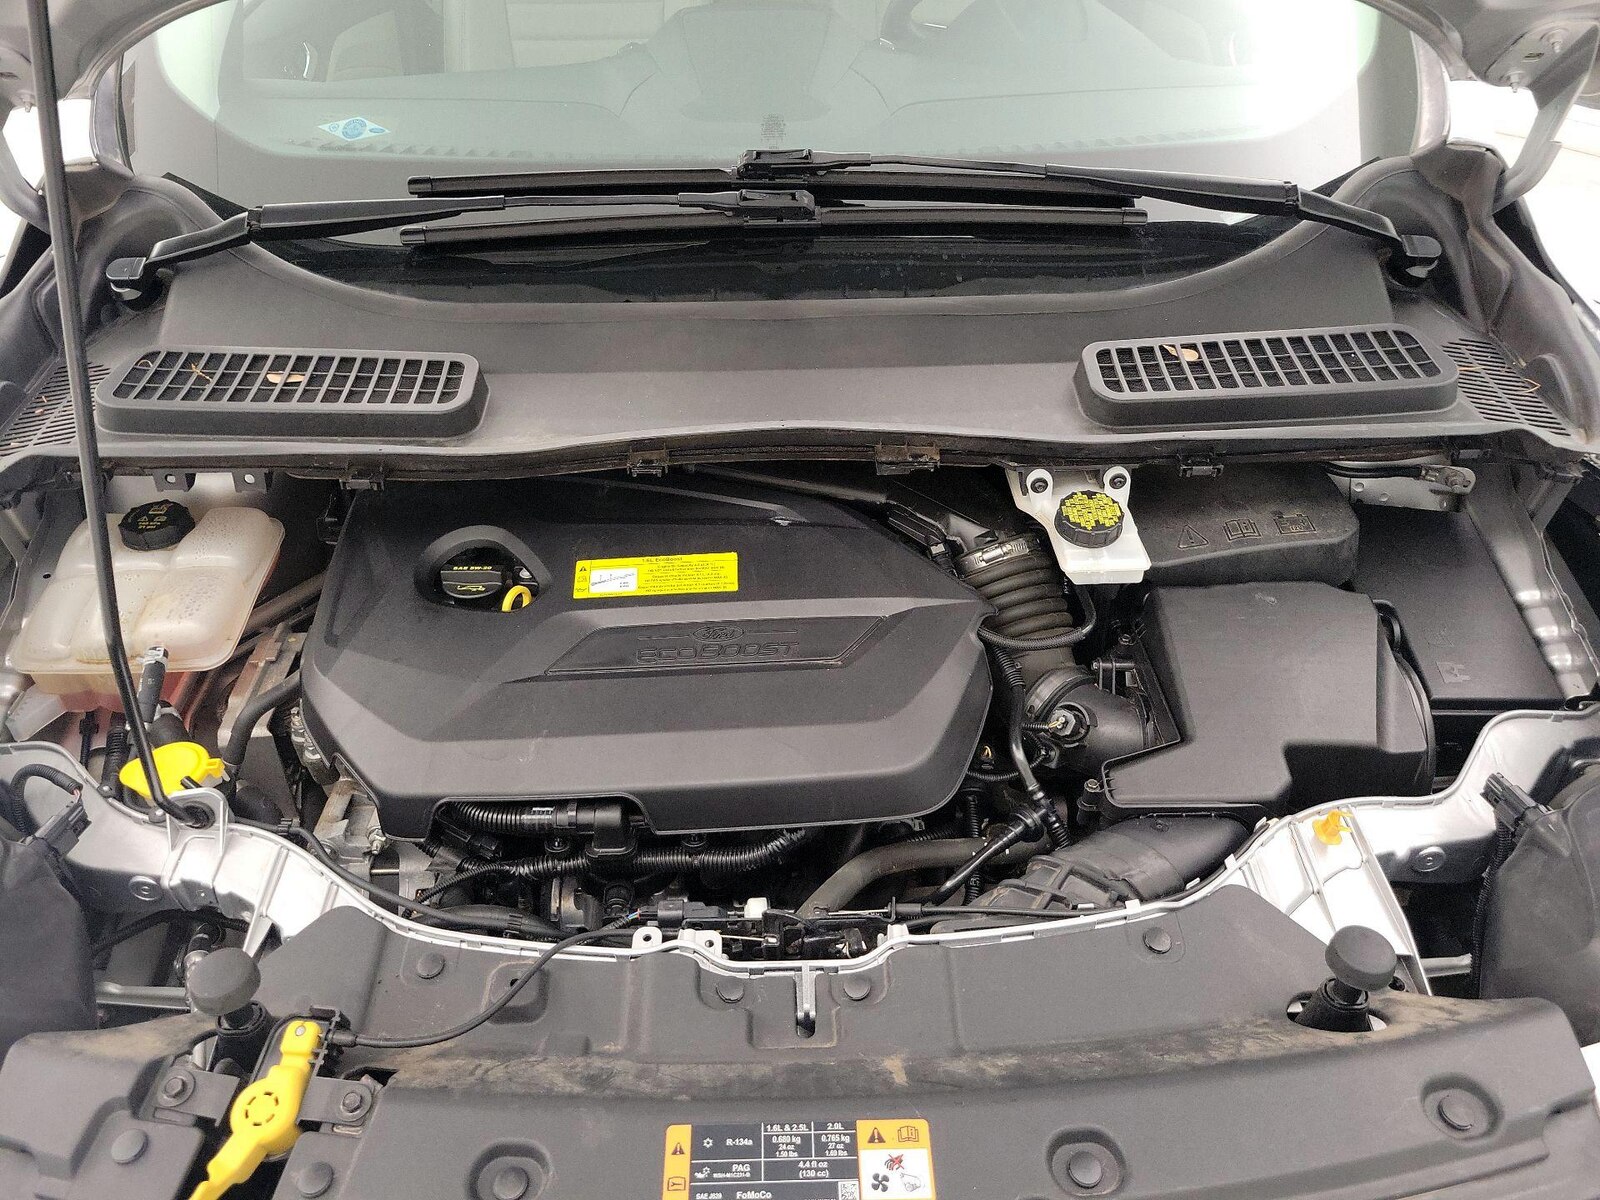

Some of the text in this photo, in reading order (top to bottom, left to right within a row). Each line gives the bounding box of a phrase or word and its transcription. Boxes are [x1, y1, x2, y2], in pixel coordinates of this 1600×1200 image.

[702, 626, 736, 640] Ford
[766, 1123, 809, 1132] 1.6L & 2.5L
[827, 1122, 845, 1130] 2.0L
[726, 1138, 753, 1146] R-134a
[772, 1135, 801, 1144] 0.680 kg
[821, 1134, 850, 1143] 0.765 kg
[732, 1164, 751, 1172] PAG
[811, 1160, 817, 1168] fl
[799, 1169, 829, 1178] (130 cc)
[736, 1190, 772, 1199] FoMoCo
